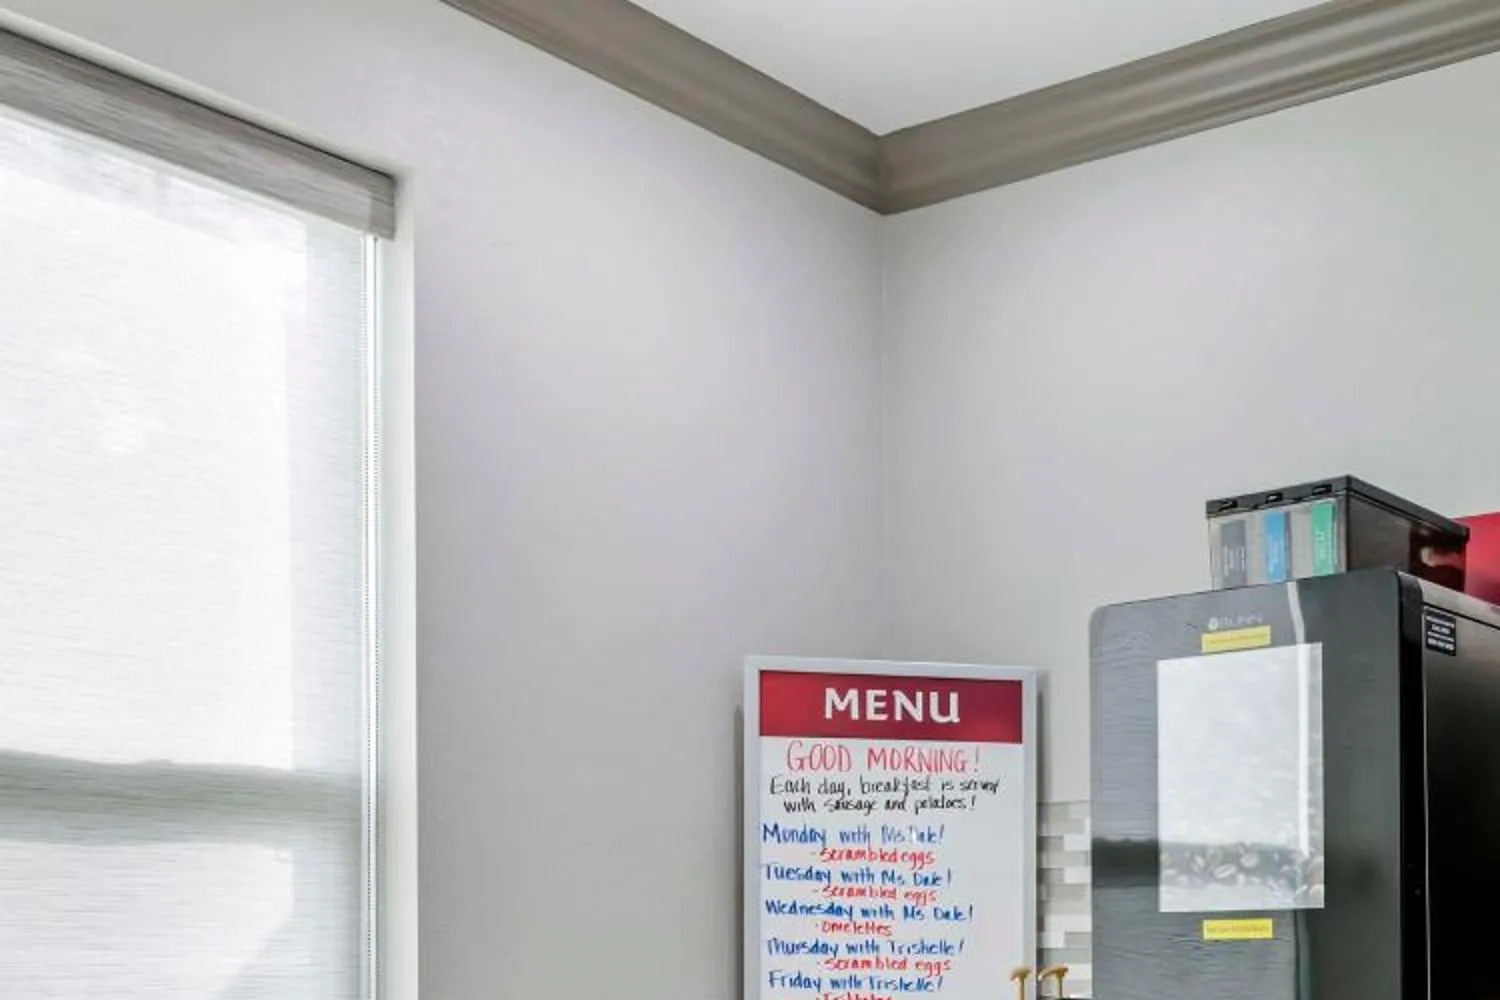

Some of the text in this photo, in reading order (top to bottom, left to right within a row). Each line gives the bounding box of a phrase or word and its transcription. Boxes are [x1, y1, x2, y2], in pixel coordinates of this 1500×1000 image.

[824, 687, 961, 724] MENU
[787, 740, 979, 773] GOOD MORNING!
[770, 775, 811, 795] Each
[818, 777, 851, 799] day,
[859, 774, 931, 798] breakfast
[783, 797, 817, 813] with
[823, 799, 878, 816] sausage
[884, 800, 908, 812] and
[762, 822, 827, 848] Monday
[839, 823, 871, 844] with
[901, 851, 936, 871] eggs
[763, 862, 831, 885] Tuesday
[841, 866, 875, 885] with
[903, 889, 937, 907] eggs
[765, 899, 853, 921] Wednesday
[860, 902, 895, 920] with
[767, 938, 839, 958] Thursday
[845, 938, 881, 955] with
[915, 959, 952, 979] eggs
[769, 970, 822, 994] Friday
[830, 973, 863, 991] with
